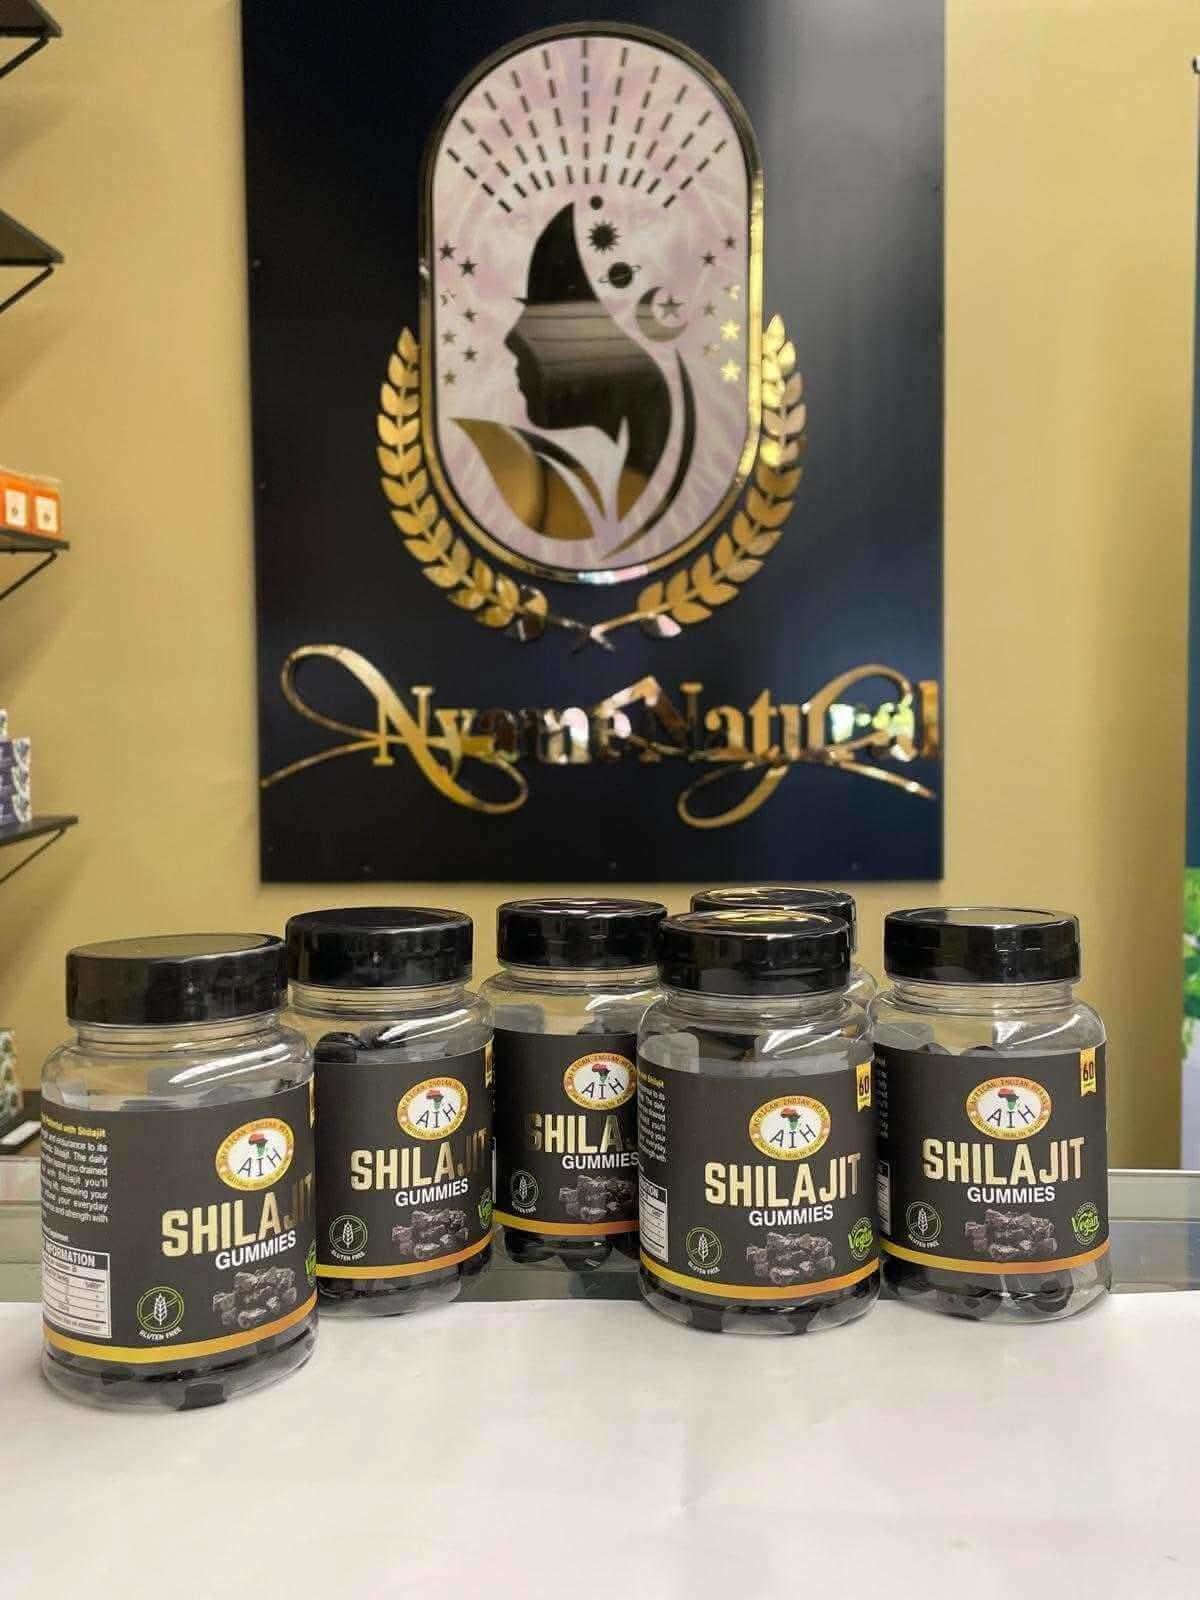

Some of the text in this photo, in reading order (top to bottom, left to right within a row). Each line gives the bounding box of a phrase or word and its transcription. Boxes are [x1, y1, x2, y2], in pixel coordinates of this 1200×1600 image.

[582, 1078, 624, 1100] AIH
[416, 1104, 456, 1128] AIH
[987, 1105, 1036, 1128] AIH
[527, 1113, 637, 1154] SHILA
[769, 1124, 816, 1148] AIH
[237, 1148, 282, 1177] AIH
[562, 1152, 639, 1169] GUMMIES
[922, 1136, 1085, 1185] SHILAJIT
[705, 1152, 861, 1207] SHILAJIT
[395, 1178, 469, 1207] GUMMIES
[967, 1186, 1055, 1204] GUMMIES
[749, 1204, 834, 1226] GUMMIES
[215, 1230, 297, 1269] GUMMIES
